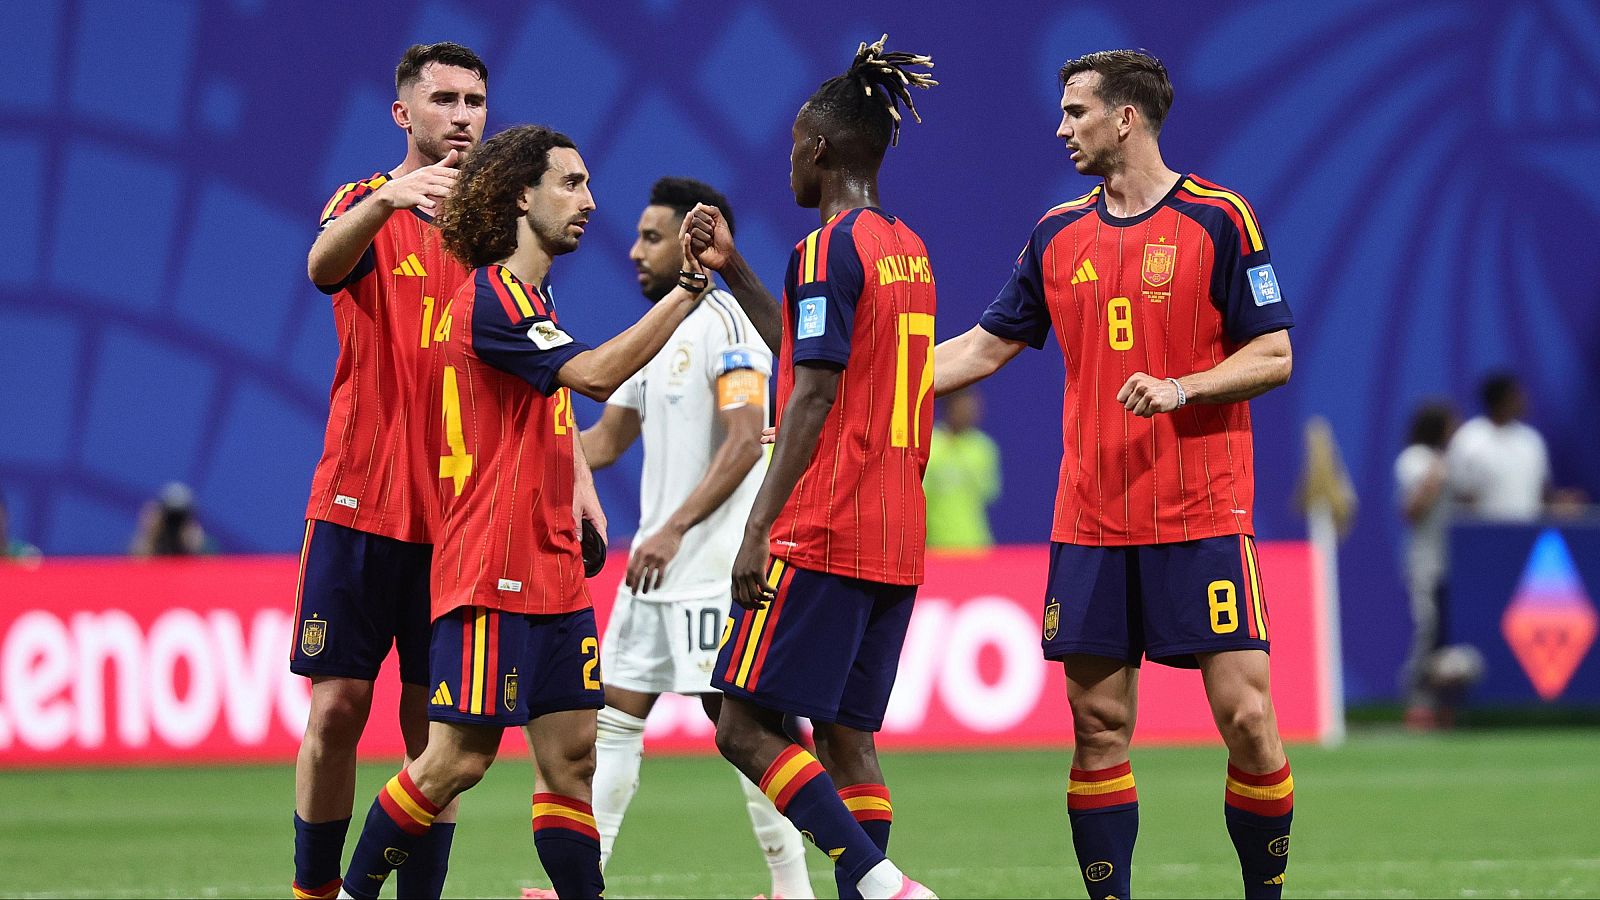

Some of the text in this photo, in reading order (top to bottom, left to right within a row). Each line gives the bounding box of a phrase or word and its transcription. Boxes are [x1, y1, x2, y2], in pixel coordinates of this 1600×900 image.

[1108, 297, 1134, 350] 8
[891, 312, 935, 448] 17
[685, 607, 721, 653] 10
[1208, 580, 1239, 634] 8
[0, 607, 313, 751] enov
[581, 637, 604, 690] 2
